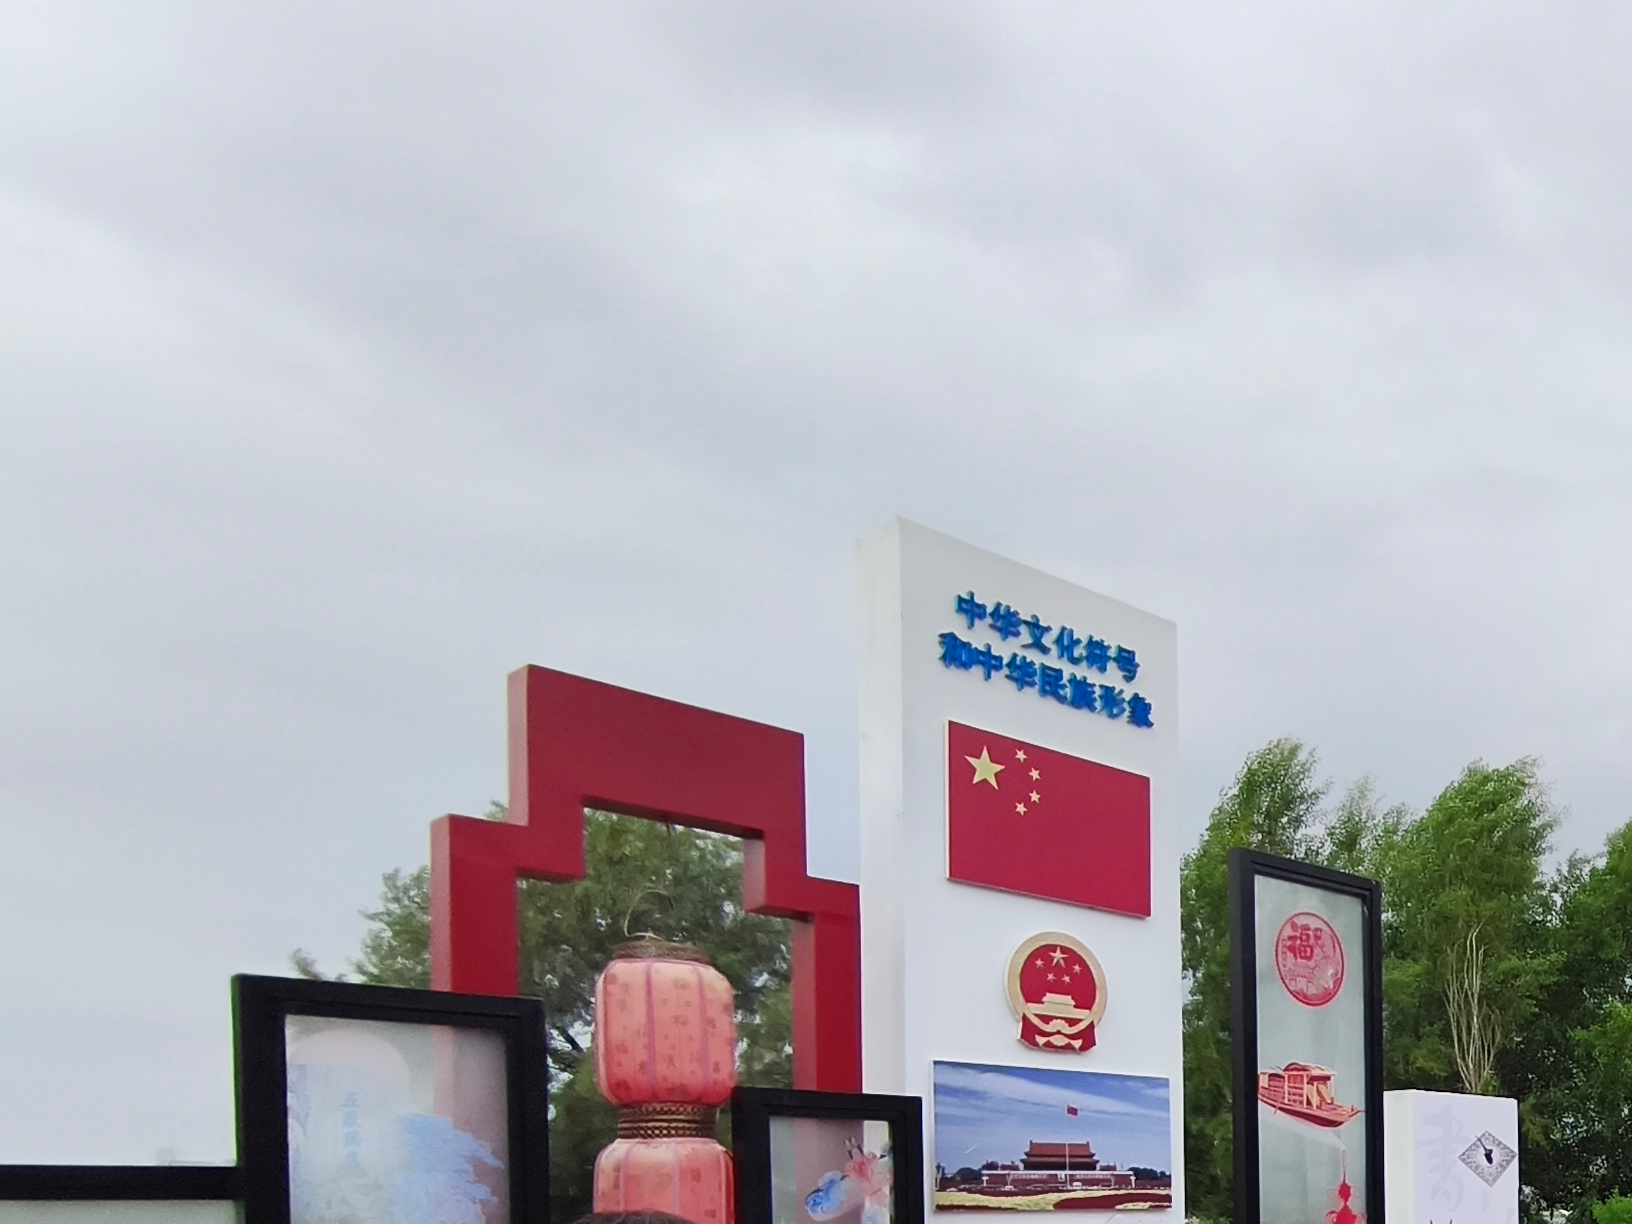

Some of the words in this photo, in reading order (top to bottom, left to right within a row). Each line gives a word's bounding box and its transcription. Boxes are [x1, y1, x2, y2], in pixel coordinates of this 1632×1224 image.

[938, 631, 1154, 728] 和中华民族形象
[954, 590, 1140, 682] 中华文化符号
